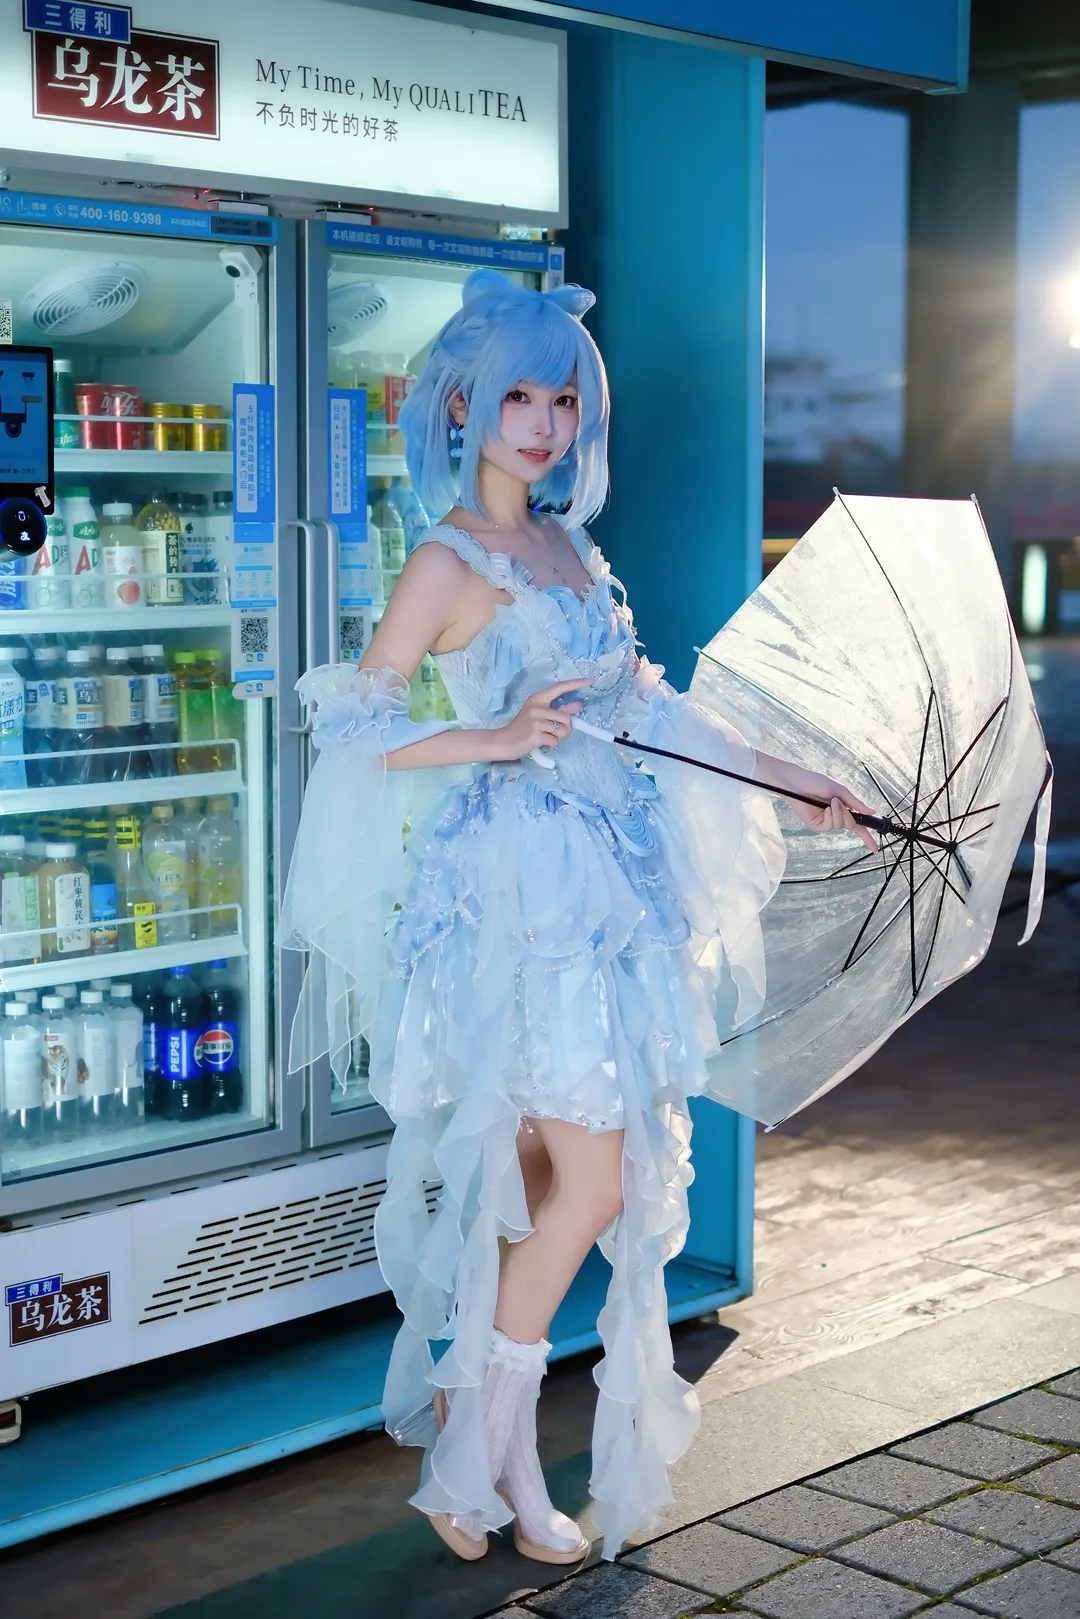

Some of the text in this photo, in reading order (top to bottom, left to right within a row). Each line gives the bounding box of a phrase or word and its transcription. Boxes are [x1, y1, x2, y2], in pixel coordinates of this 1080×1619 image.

[44, 3, 112, 36] 三得利
[47, 38, 206, 121] 乌龙茶
[255, 58, 292, 93] My
[371, 76, 403, 109] My
[256, 101, 399, 142] 不负时光的好茶
[79, 206, 162, 226] 400-160-9398
[170, 1036, 180, 1073] PEPSI
[16, 1280, 53, 1300] 三得利
[18, 1285, 103, 1332] 乌龙茶
